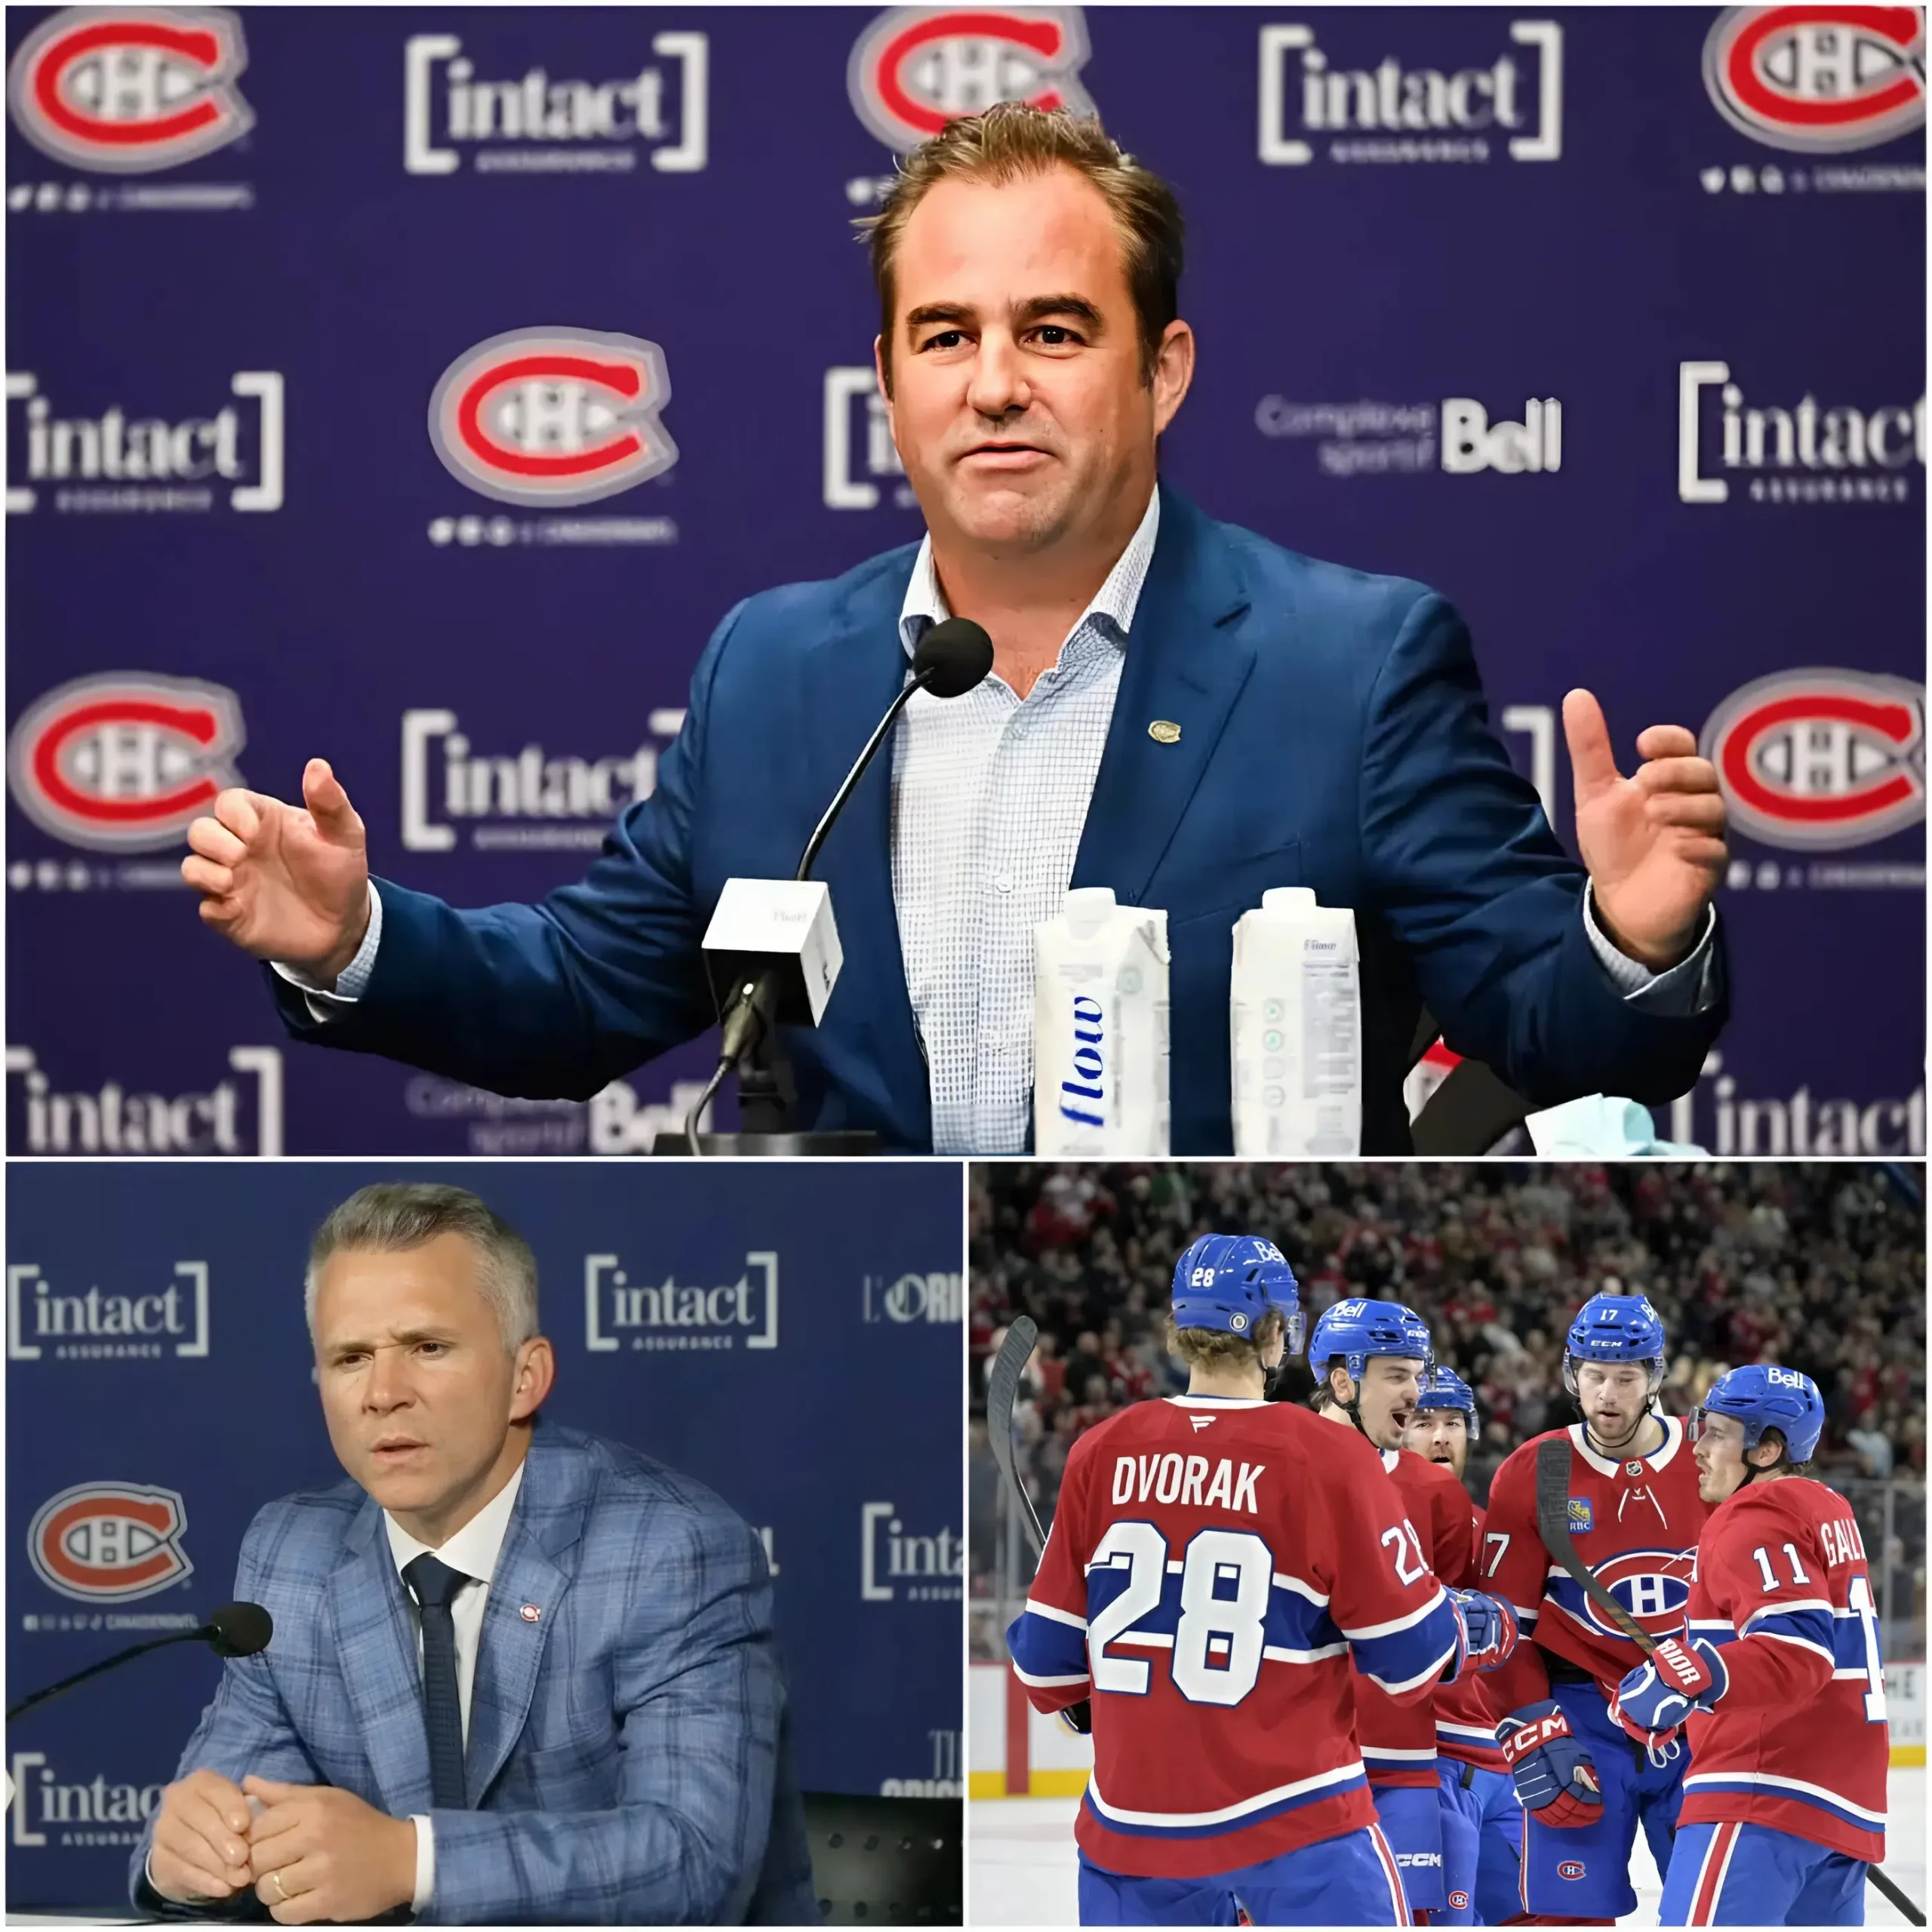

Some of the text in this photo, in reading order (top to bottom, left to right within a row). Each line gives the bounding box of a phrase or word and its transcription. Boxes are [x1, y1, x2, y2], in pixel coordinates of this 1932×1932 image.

[1441, 398, 1561, 474] Bell
[1060, 997, 1104, 1127] flow
[612, 1270, 755, 1327] intact
[1191, 1267, 1215, 1287] 28
[35, 1280, 186, 1336] intact
[1333, 1301, 1367, 1318] Bell
[1600, 1309, 1618, 1321] 17
[1767, 1367, 1805, 1390] Bell
[1112, 1453, 1266, 1515] DVORAK
[1752, 1542, 1811, 1594] 11
[1086, 1520, 1274, 1708] 28
[1848, 1574, 1887, 1723] 1
[1503, 1717, 1567, 1762] CCM
[1395, 1853, 1441, 1867] CCM
